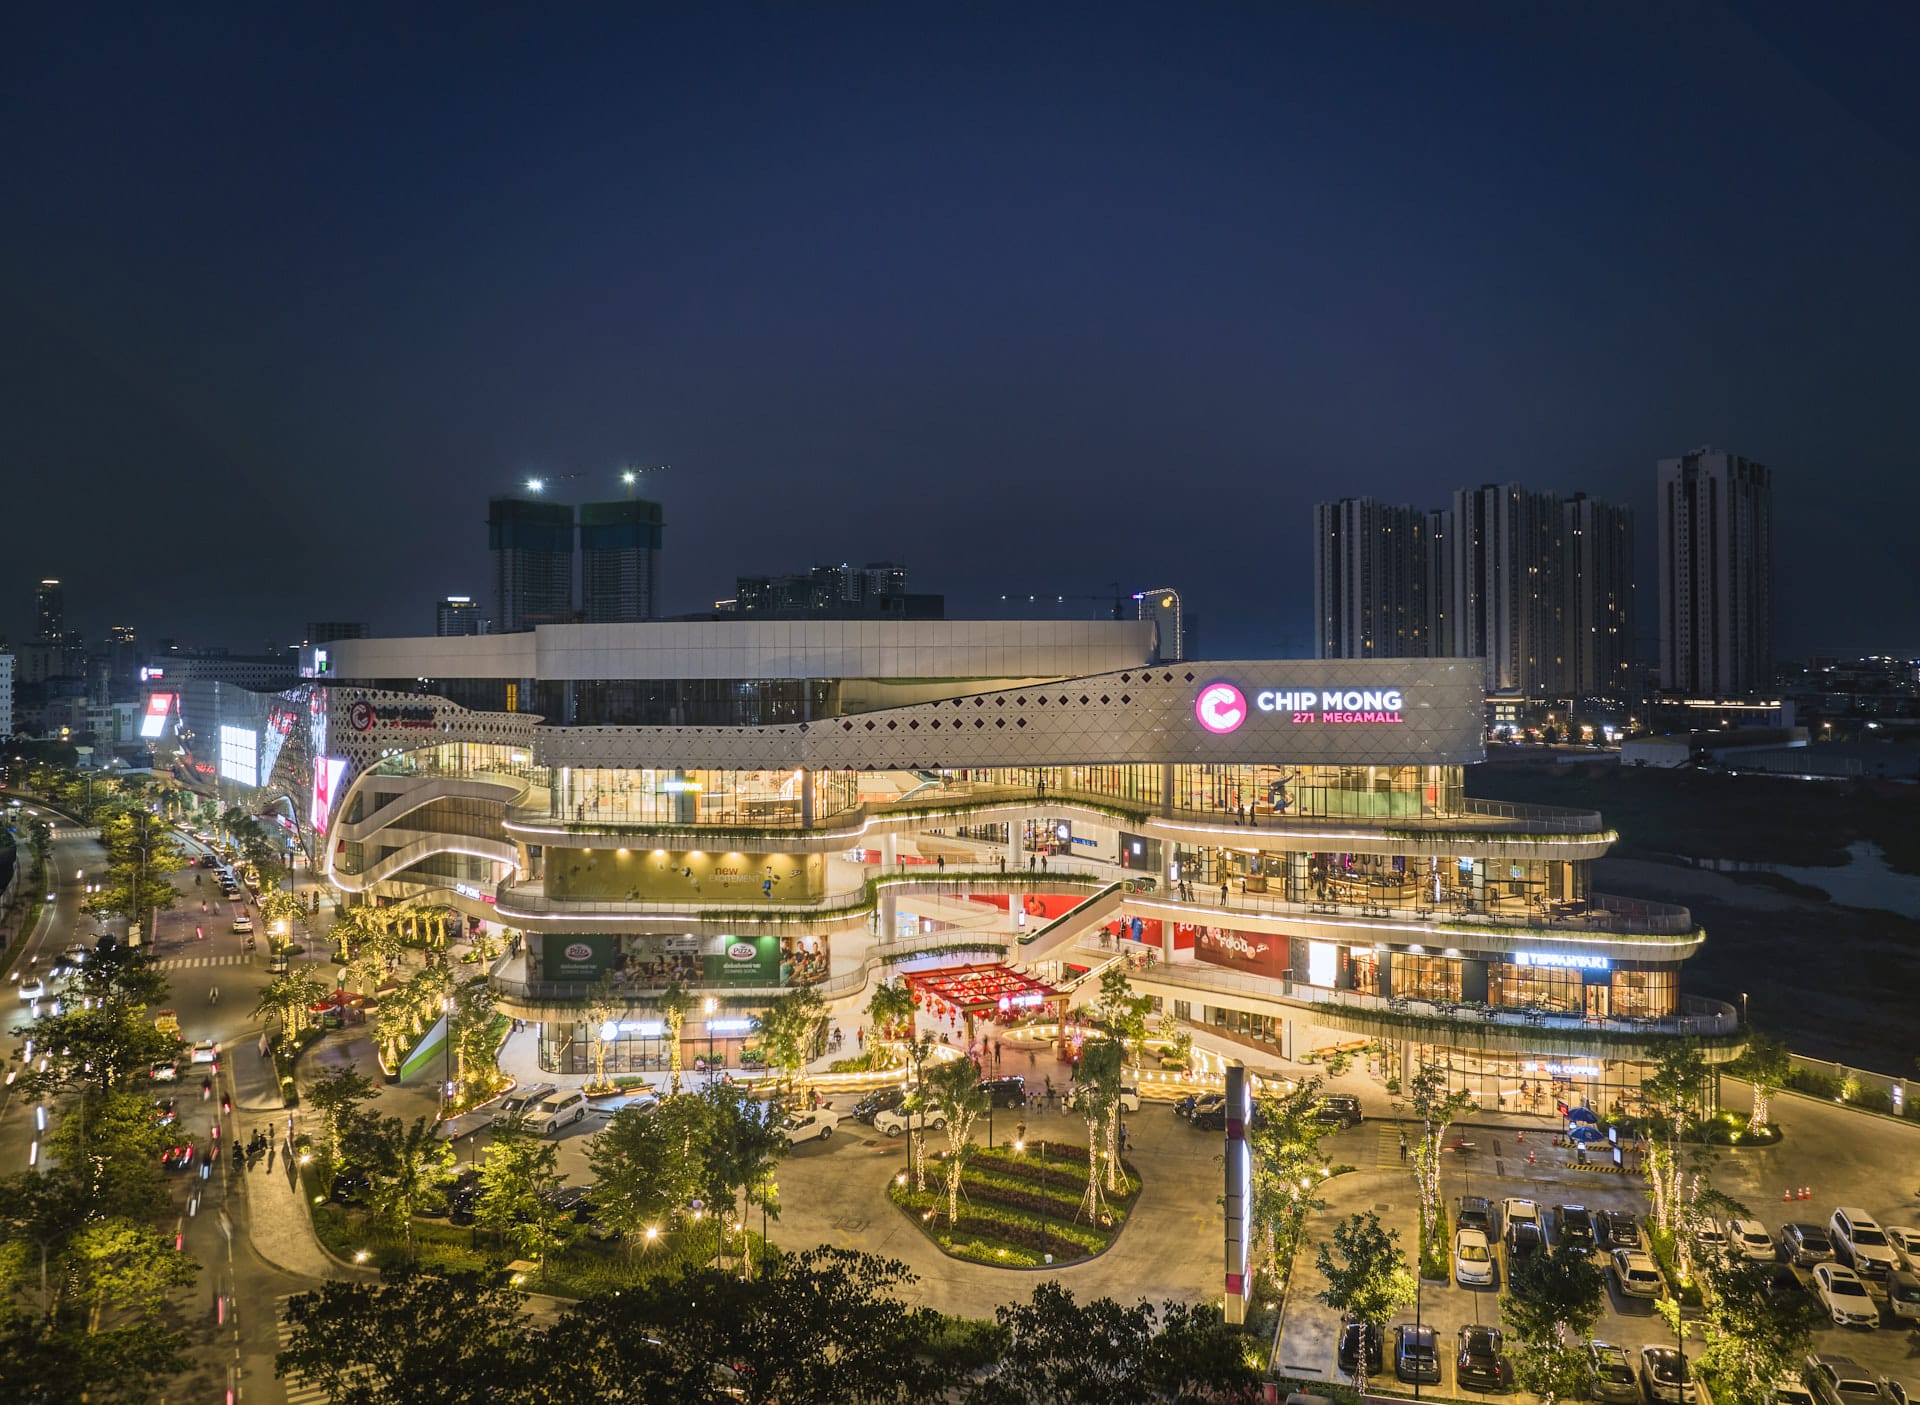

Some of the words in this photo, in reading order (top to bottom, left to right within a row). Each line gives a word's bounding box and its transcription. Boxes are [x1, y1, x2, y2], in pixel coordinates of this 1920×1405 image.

[1257, 691, 1317, 711] CHIP
[1322, 691, 1402, 711] MONG
[1293, 712, 1315, 723] 271
[1322, 712, 1403, 723] MEGAMALL
[715, 867, 738, 875] new
